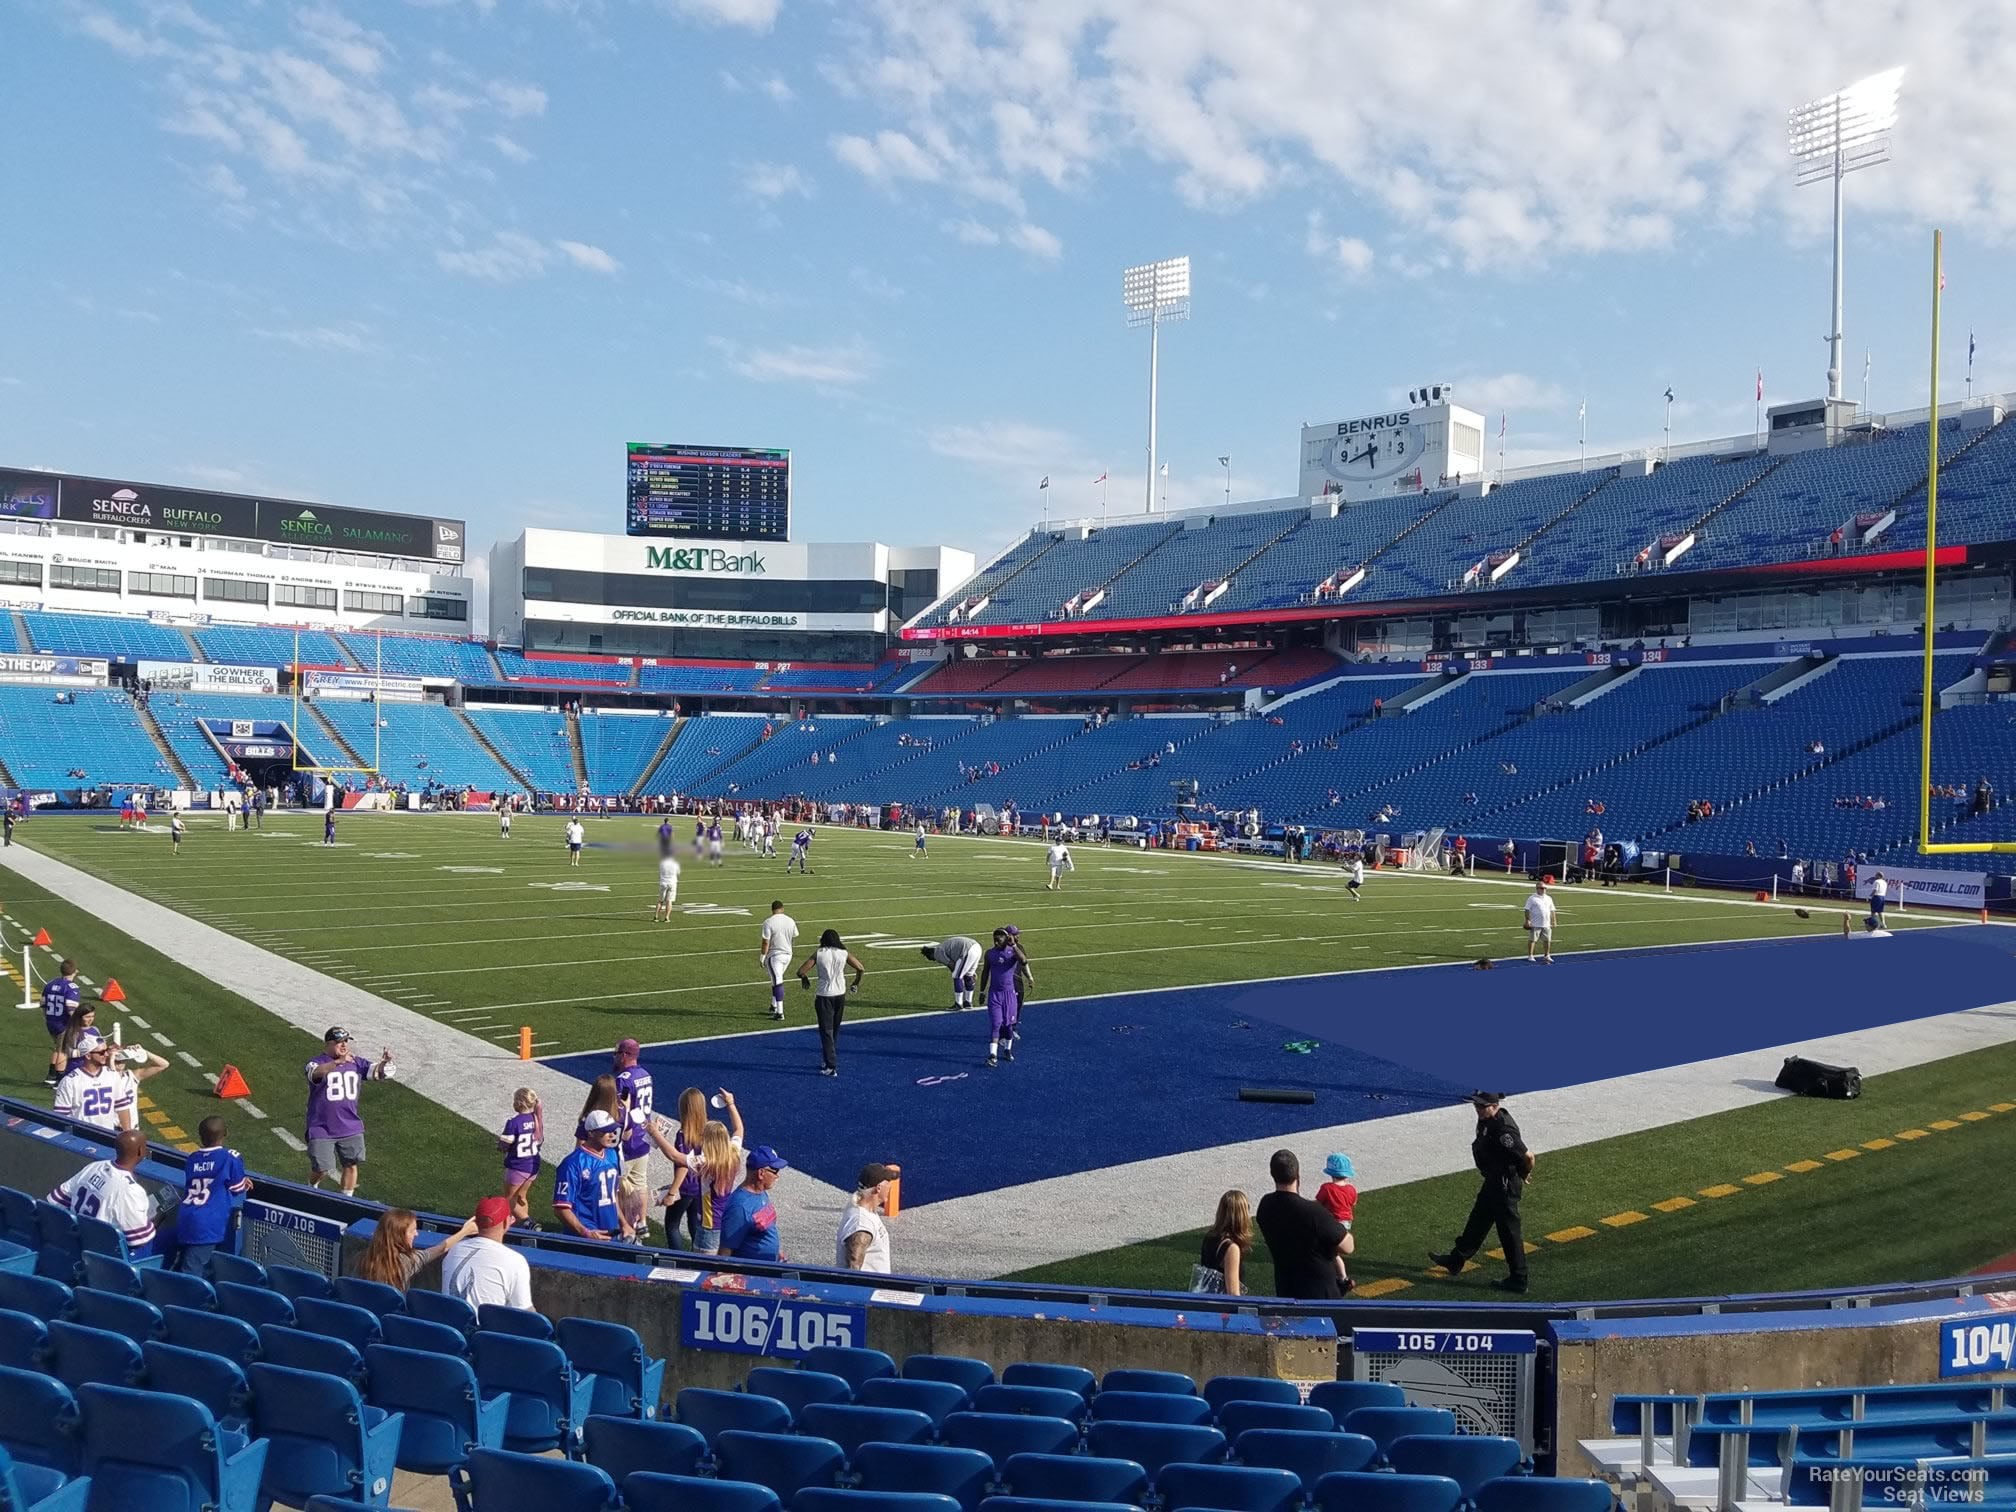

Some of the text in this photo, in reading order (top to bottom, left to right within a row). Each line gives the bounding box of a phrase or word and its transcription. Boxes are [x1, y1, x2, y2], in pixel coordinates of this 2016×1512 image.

[1338, 413, 1410, 435] BENRUS
[1397, 442, 1404, 454] 3
[1341, 451, 1348, 462] 9
[92, 499, 152, 516] SENECA
[93, 513, 151, 525] BUFFALO CREEK
[163, 507, 222, 524] BUFFALO
[167, 520, 218, 531] NEW YORK
[280, 519, 333, 536] SENECA
[437, 551, 460, 559] FIELD
[646, 545, 766, 573] M&T Bank
[613, 610, 797, 625] OFFICIAL BANK OF THE BUFFALO BILLS
[1592, 651, 1661, 664] 133 134
[213, 667, 265, 677] GO WHERE
[1426, 659, 1487, 672] 132 133
[208, 675, 227, 683] THE
[229, 676, 254, 685] BILLS
[245, 745, 275, 756] BILLS
[326, 1071, 359, 1101] 80
[83, 1087, 112, 1117] 25
[637, 1086, 652, 1115] 33
[88, 1174, 105, 1190] KELLY
[556, 1182, 569, 1195] 12
[182, 1178, 214, 1206] 25
[694, 1299, 852, 1355] 106/105
